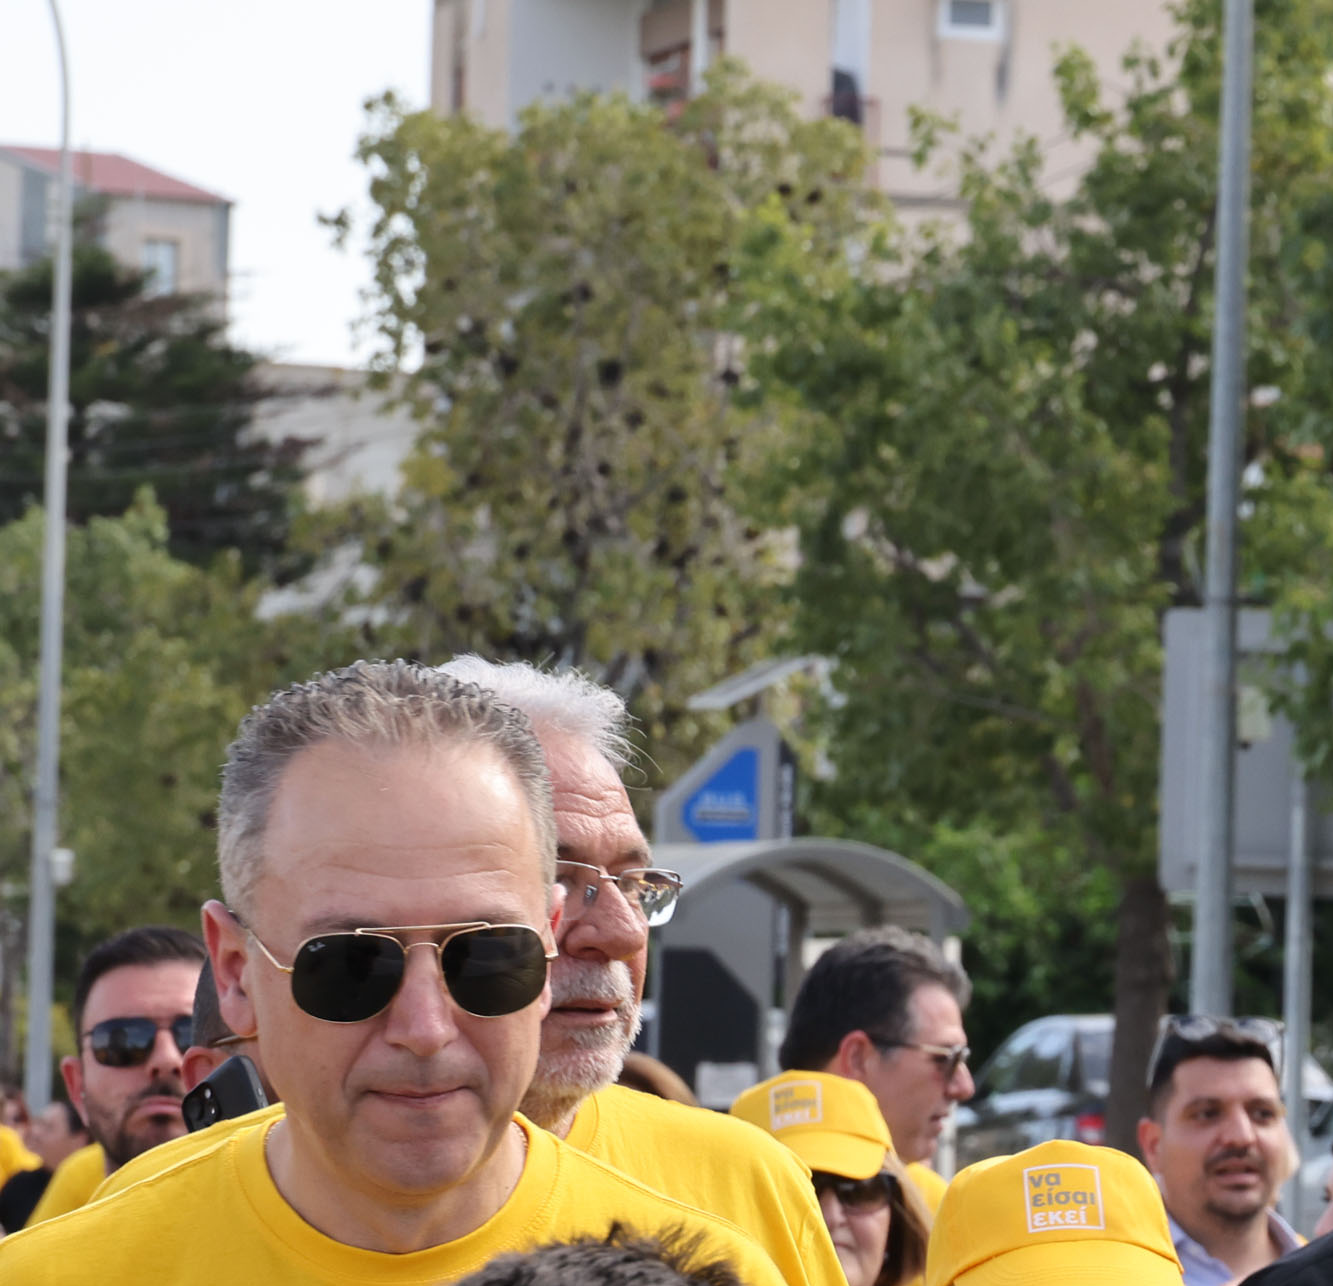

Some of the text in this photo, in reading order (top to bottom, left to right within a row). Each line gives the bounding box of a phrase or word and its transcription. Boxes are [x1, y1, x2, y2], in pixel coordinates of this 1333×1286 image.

[1029, 1173, 1060, 1188] να
[1032, 1188, 1096, 1207] είσαι
[1033, 1206, 1087, 1226] εκεί
